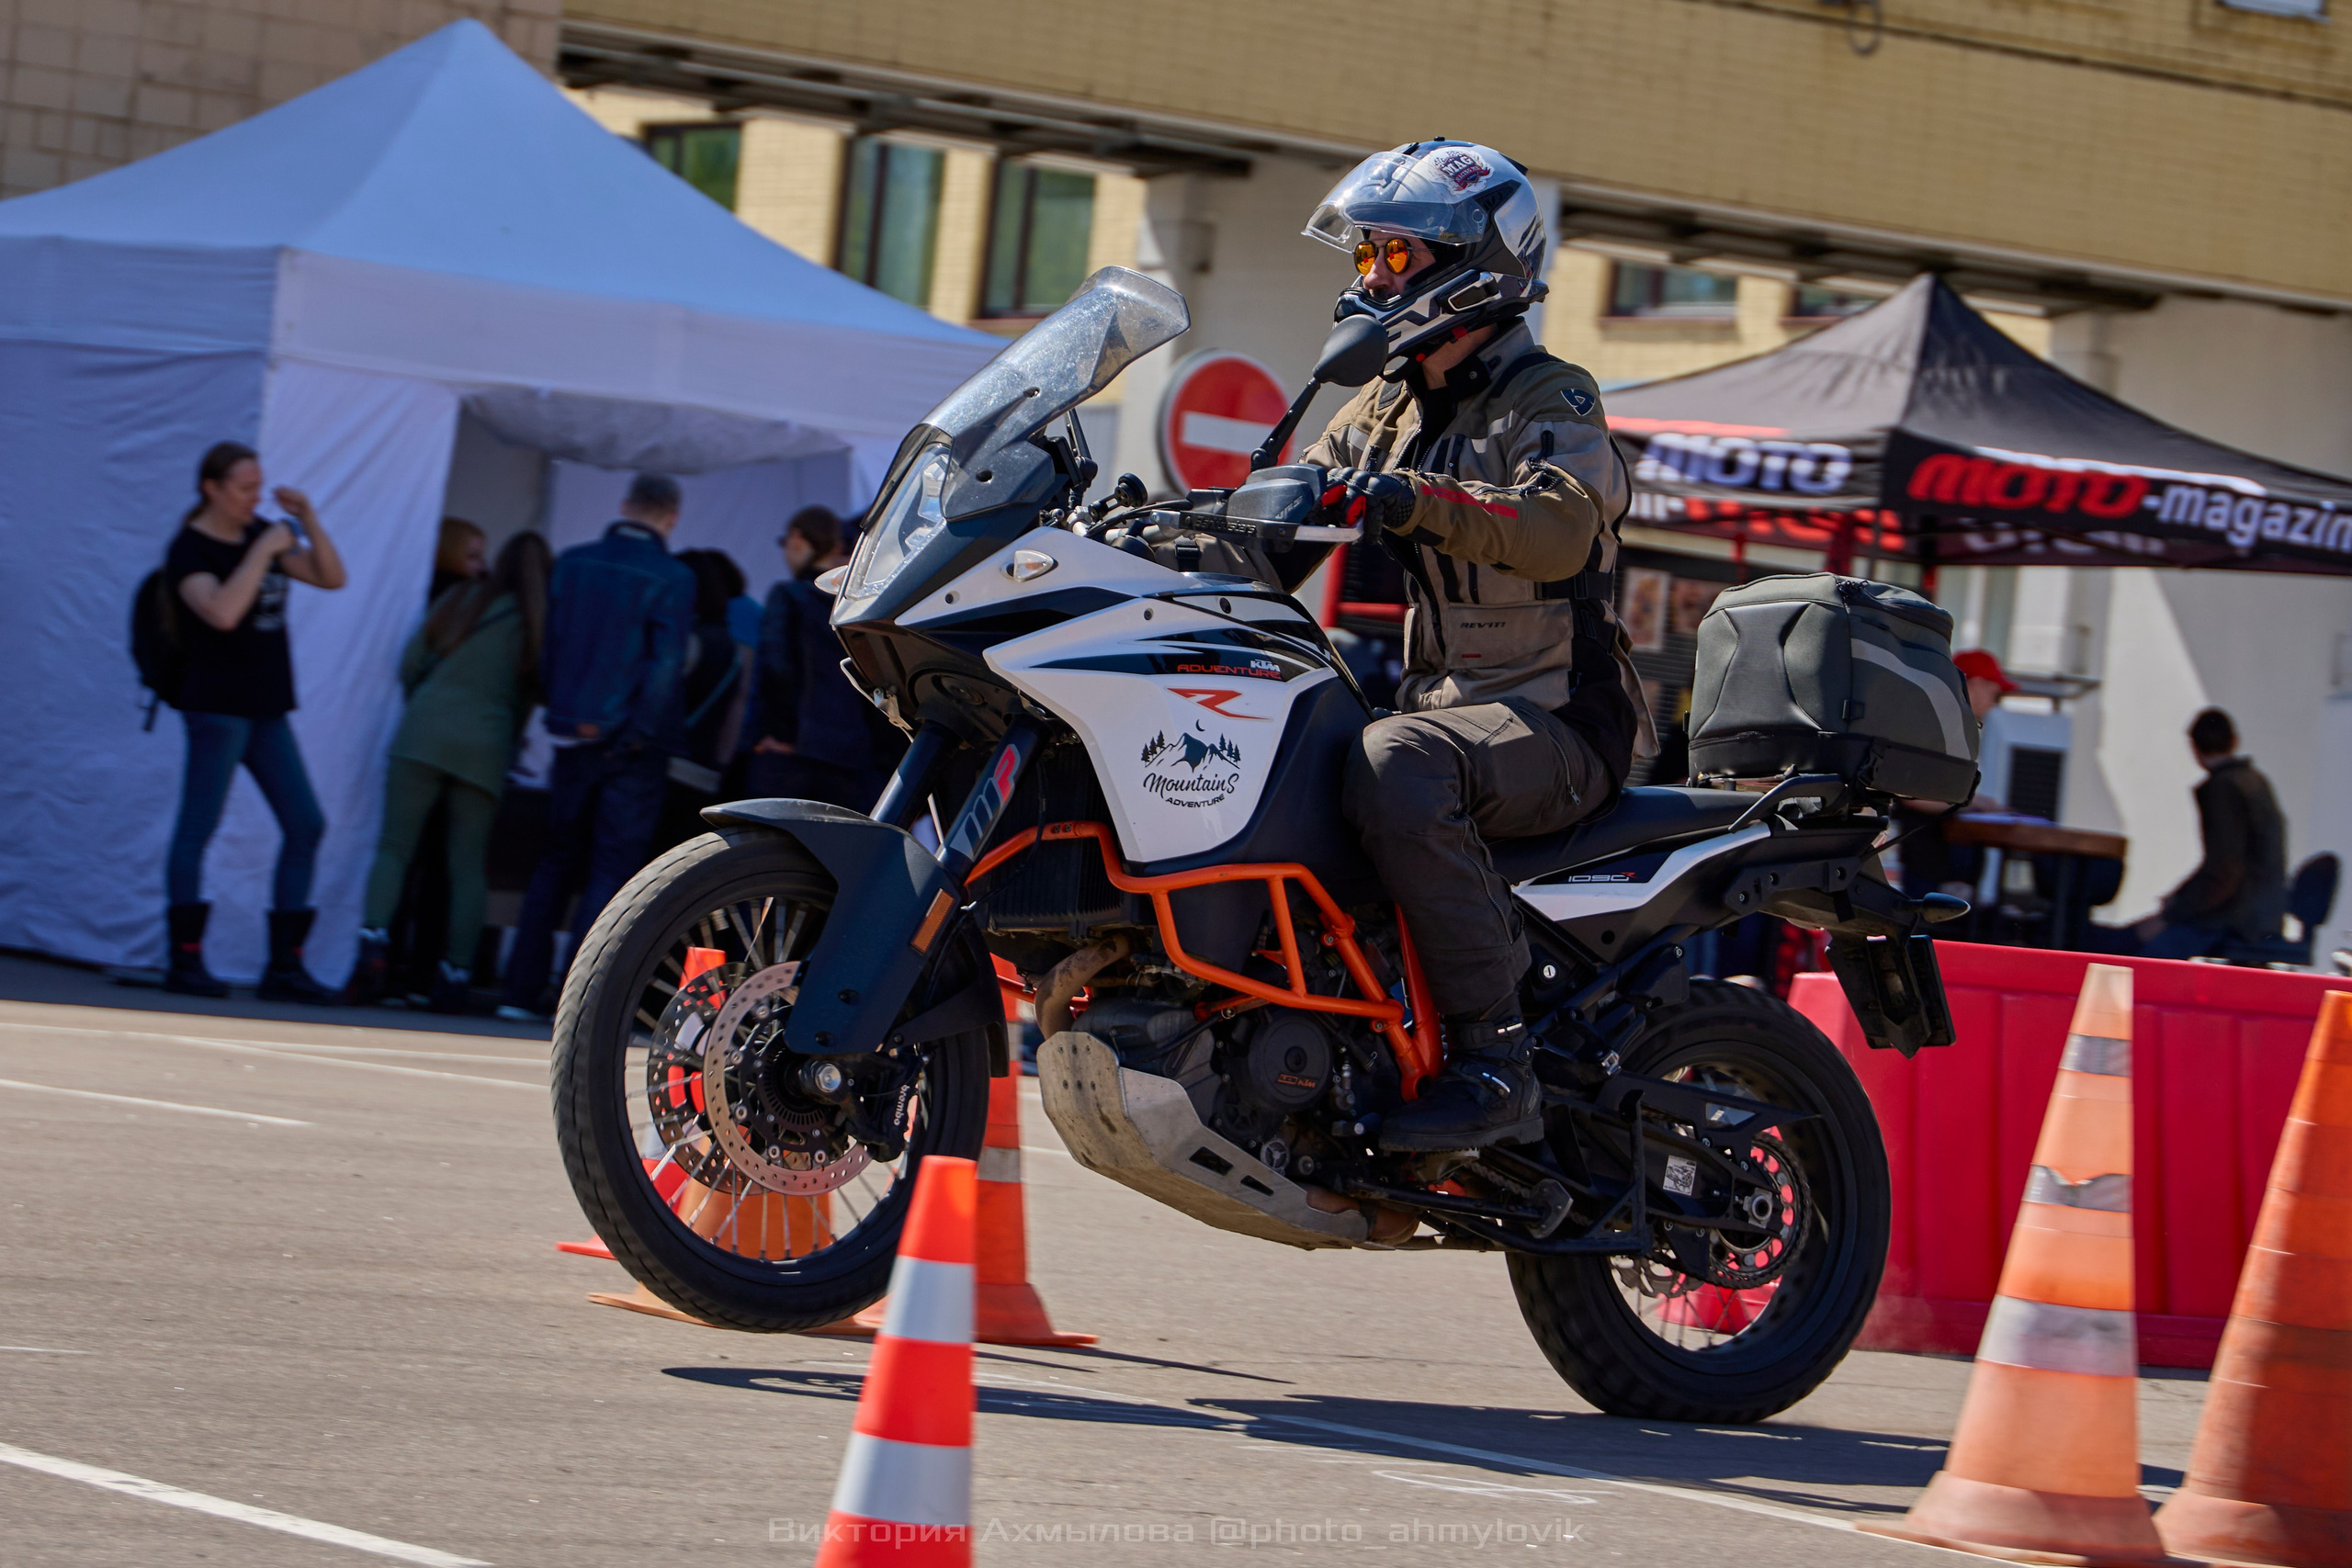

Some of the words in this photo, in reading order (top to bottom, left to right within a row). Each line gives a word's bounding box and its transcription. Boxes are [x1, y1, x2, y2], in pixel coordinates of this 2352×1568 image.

[1442, 155, 1474, 175] MAG
[1177, 663, 1282, 680] ADVENTURE
[1250, 659, 1281, 672] KTM
[1165, 794, 1226, 808] ADVENTURE
[893, 1084, 910, 1126] brembo
